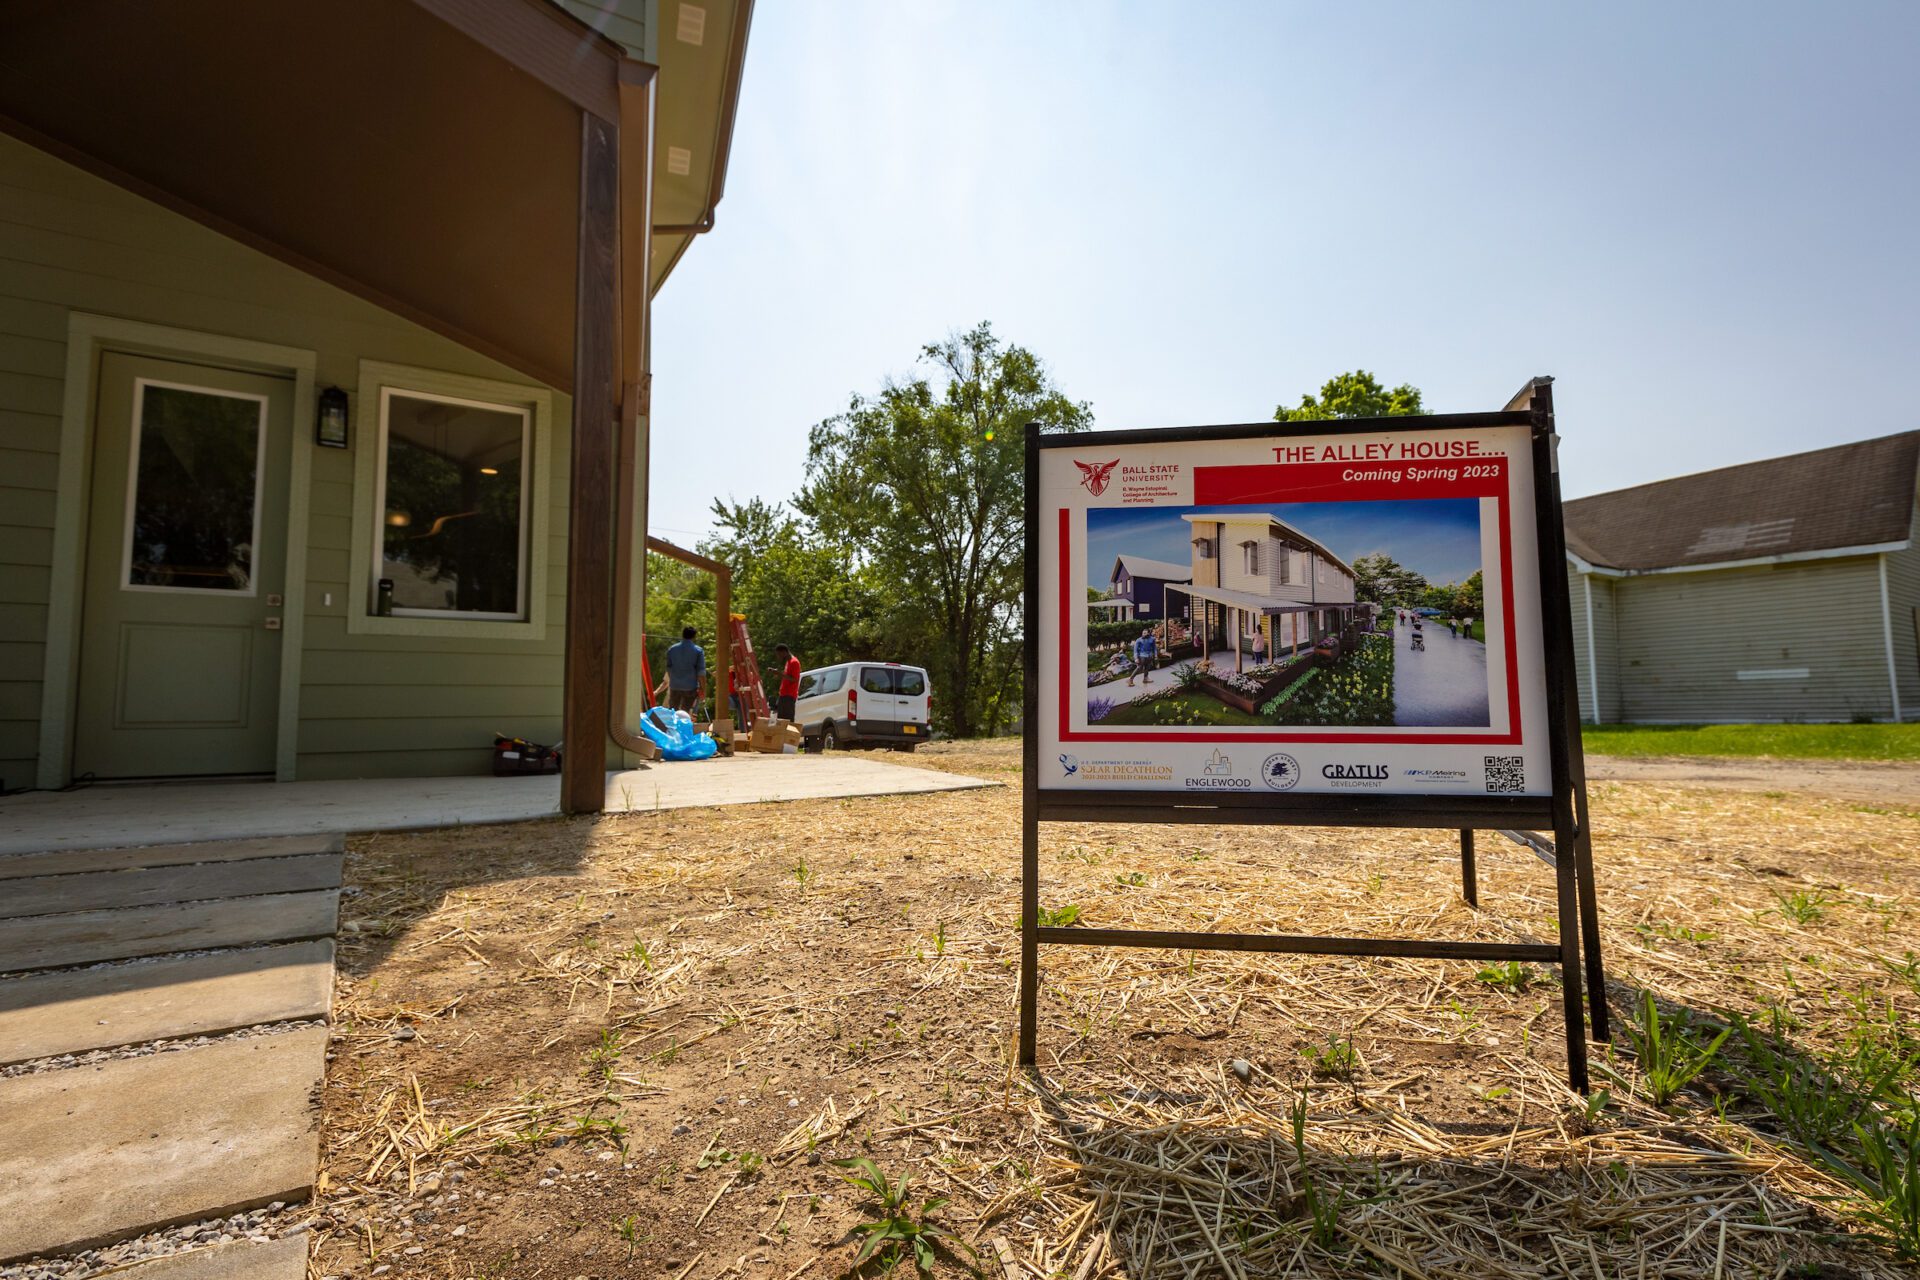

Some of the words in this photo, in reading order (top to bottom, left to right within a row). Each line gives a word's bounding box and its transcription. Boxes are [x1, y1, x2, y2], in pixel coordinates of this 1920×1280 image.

[1272, 447, 1315, 462] THE
[1321, 444, 1394, 461] ALLEY
[1122, 466, 1147, 474] BALL
[1149, 465, 1179, 473] STATE
[1342, 469, 1401, 482] Coming
[1406, 467, 1458, 482] Spring
[1463, 465, 1499, 478] 2023
[1081, 766, 1111, 774] SOLAR
[1113, 766, 1173, 774] DECATHLON
[1322, 764, 1389, 779] GRATUS
[1186, 778, 1251, 787] ENGLEWOOD
